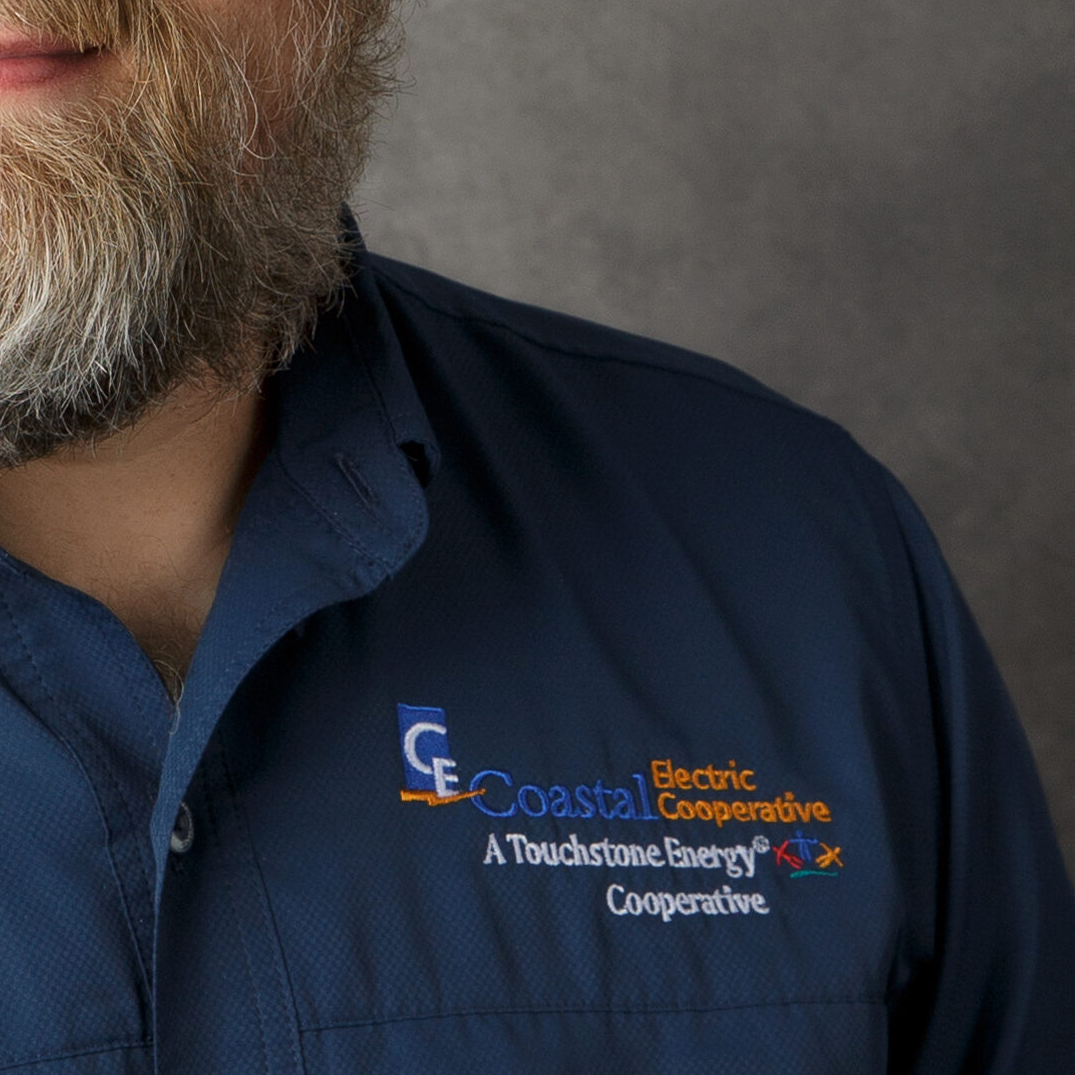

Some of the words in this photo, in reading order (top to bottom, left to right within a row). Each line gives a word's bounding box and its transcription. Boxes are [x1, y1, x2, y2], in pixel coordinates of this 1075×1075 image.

[651, 759, 756, 791] Electric
[469, 770, 658, 820] Coastal
[657, 791, 831, 827] Cooperative
[483, 833, 505, 865] A
[506, 834, 665, 868] Touchstone
[607, 883, 770, 922] Cooperative
